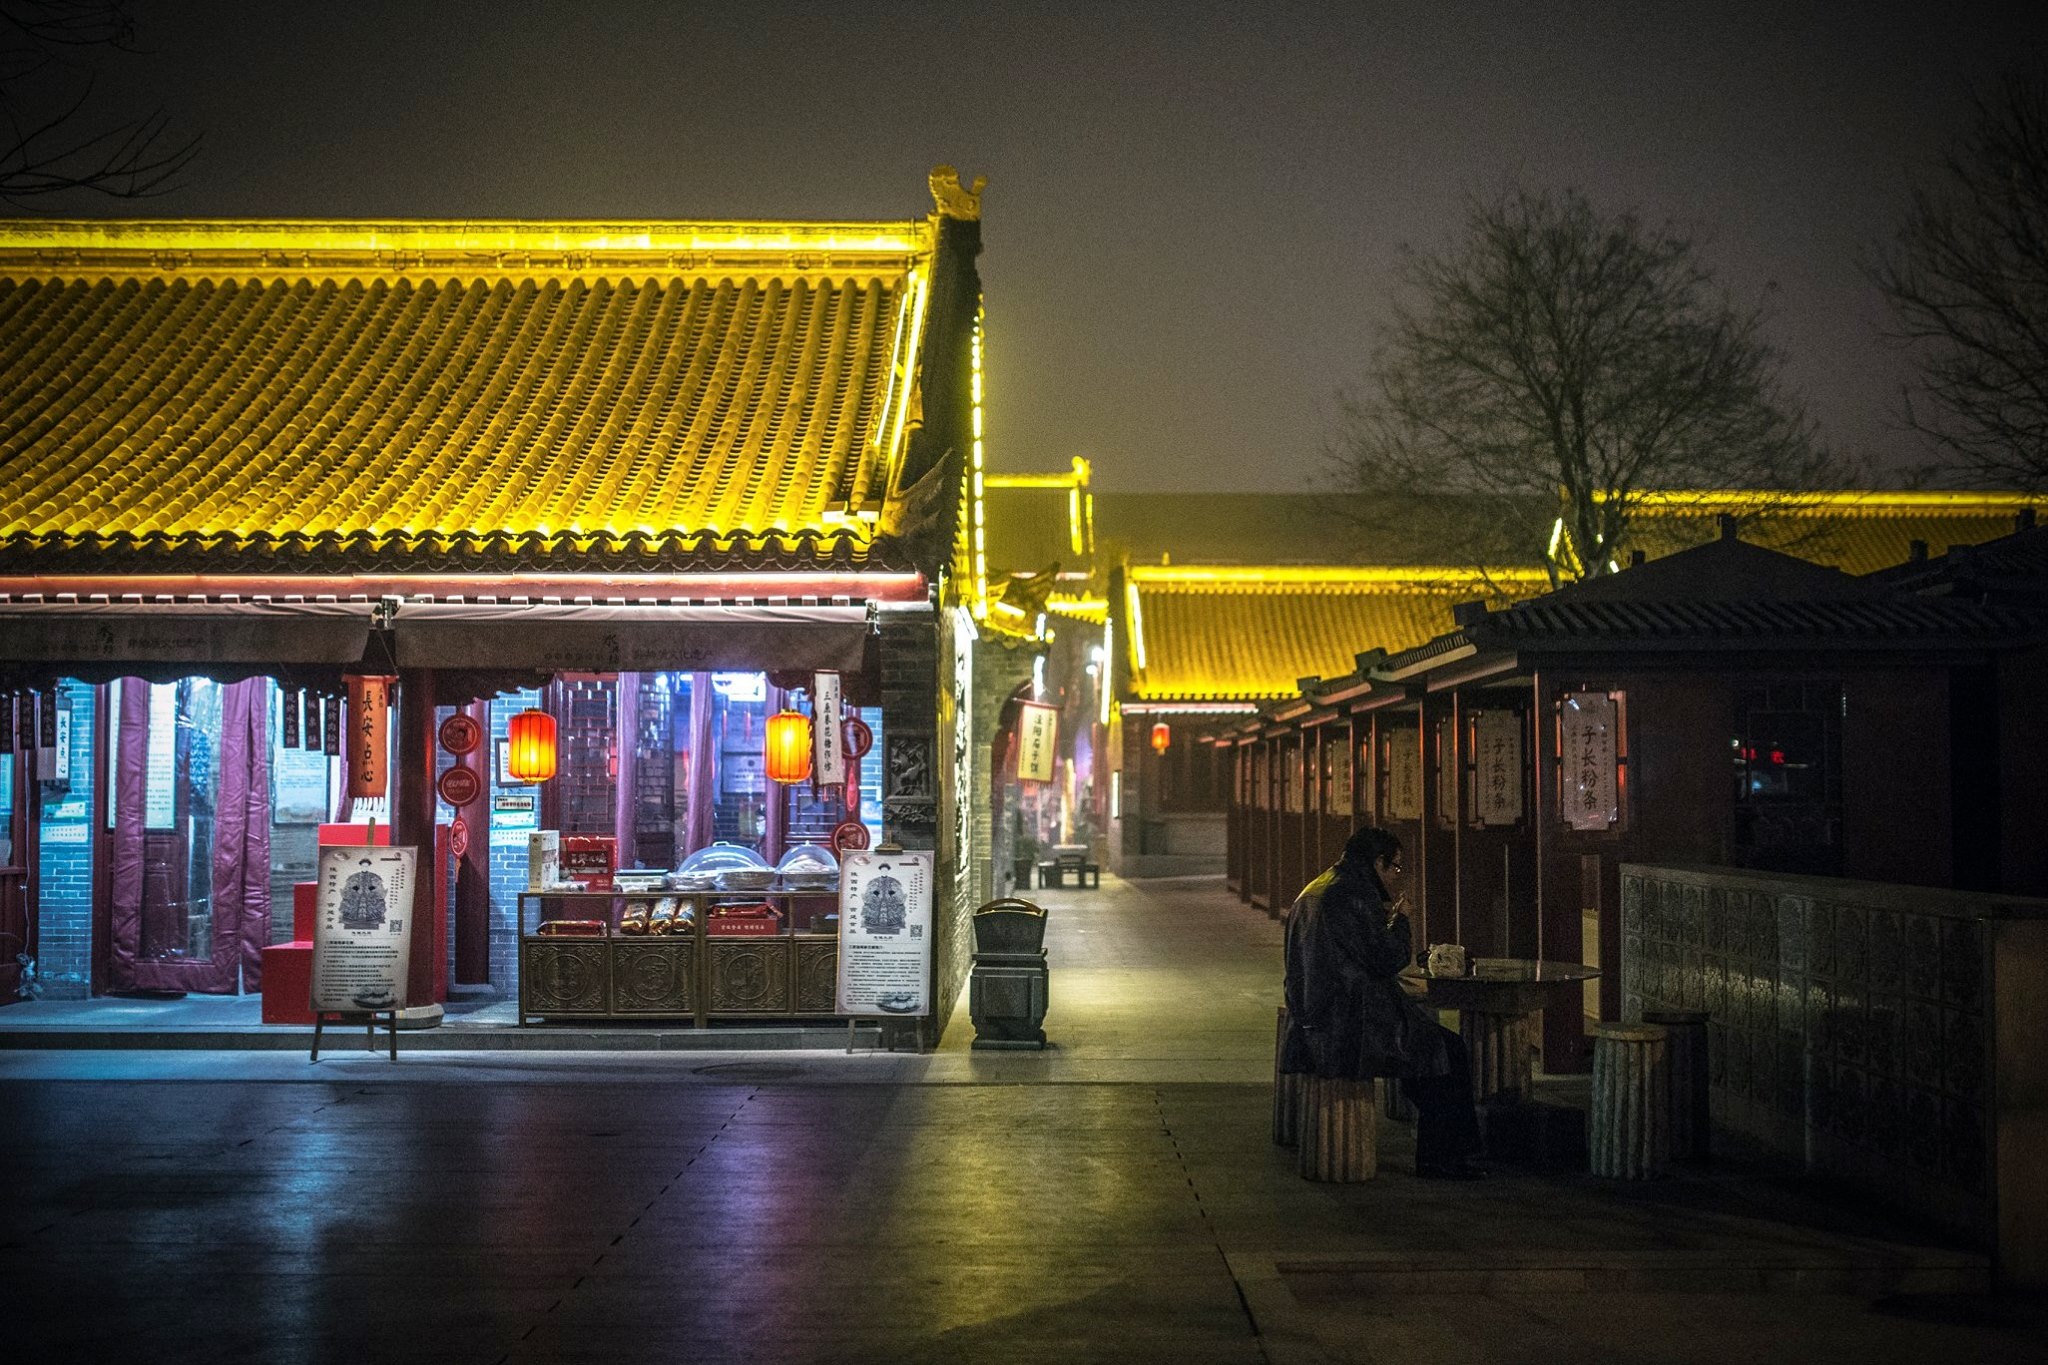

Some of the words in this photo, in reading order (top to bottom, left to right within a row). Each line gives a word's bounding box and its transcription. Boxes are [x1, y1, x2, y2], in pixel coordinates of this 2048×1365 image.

[1492, 737, 1506, 812] 子长粉条
[1581, 726, 1598, 810] 子长粉条
